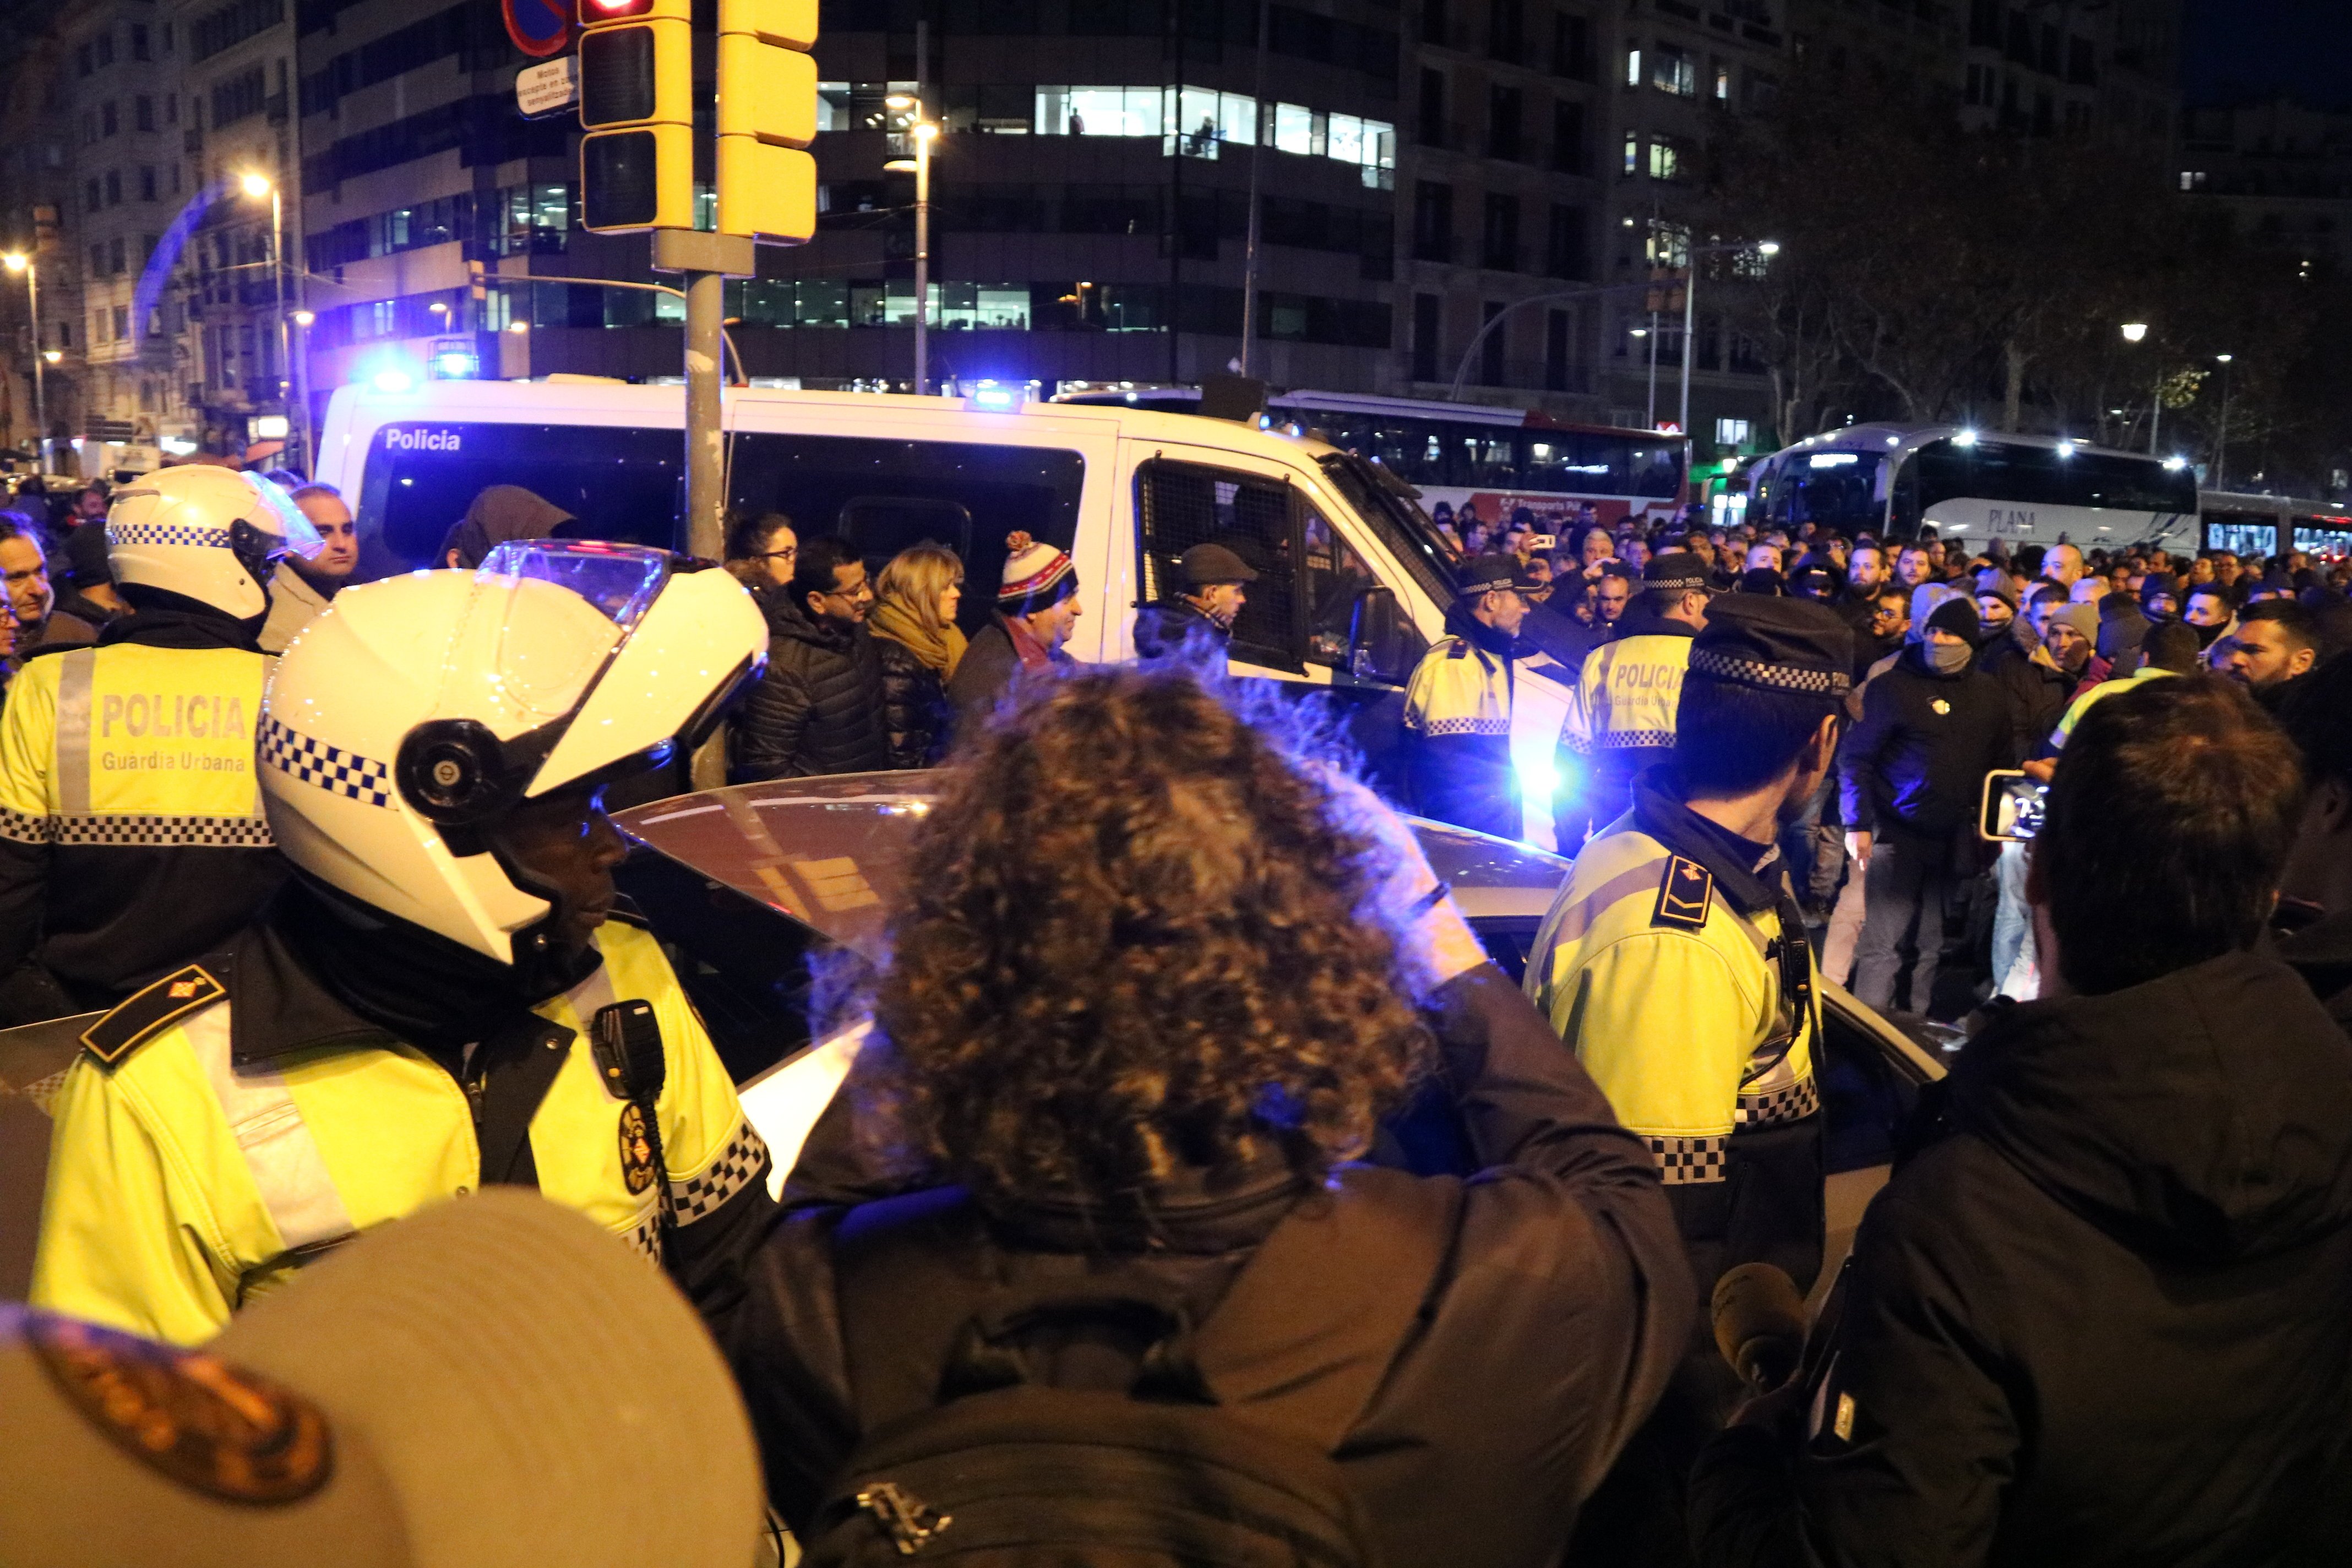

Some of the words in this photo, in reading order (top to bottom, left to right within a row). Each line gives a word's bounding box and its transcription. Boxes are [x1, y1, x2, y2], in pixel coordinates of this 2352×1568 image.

[386, 428, 461, 450] Policia
[1987, 509, 2035, 535] PLANA
[102, 693, 247, 740] POLICIA
[181, 751, 246, 772] Urbana
